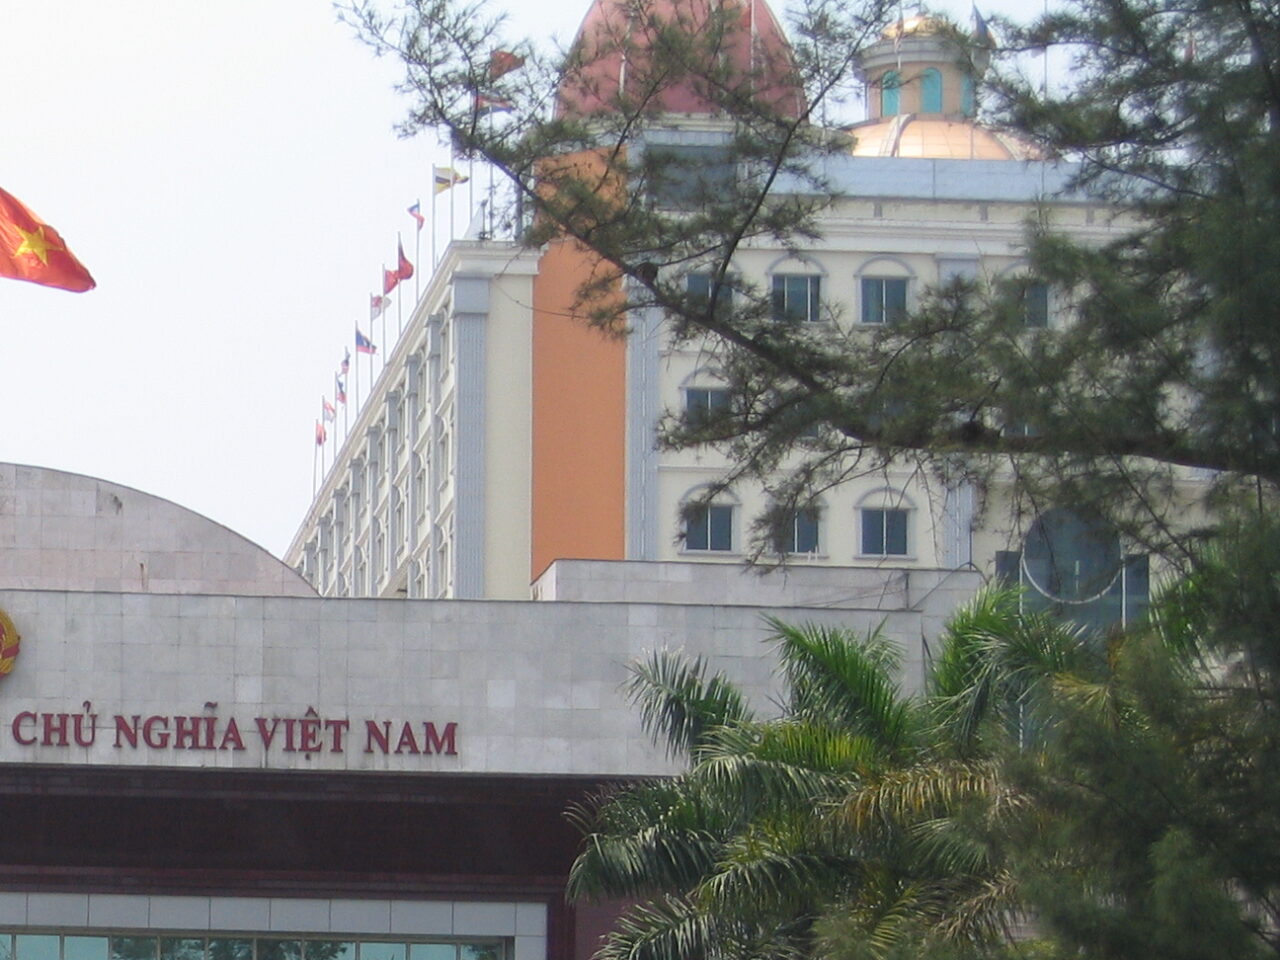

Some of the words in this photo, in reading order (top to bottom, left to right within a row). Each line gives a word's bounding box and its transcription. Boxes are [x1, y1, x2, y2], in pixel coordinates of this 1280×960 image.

[12, 701, 97, 748] CHỦ
[113, 702, 246, 751] NGHĨA
[254, 707, 350, 760] VIỆT
[365, 720, 459, 756] NAM
